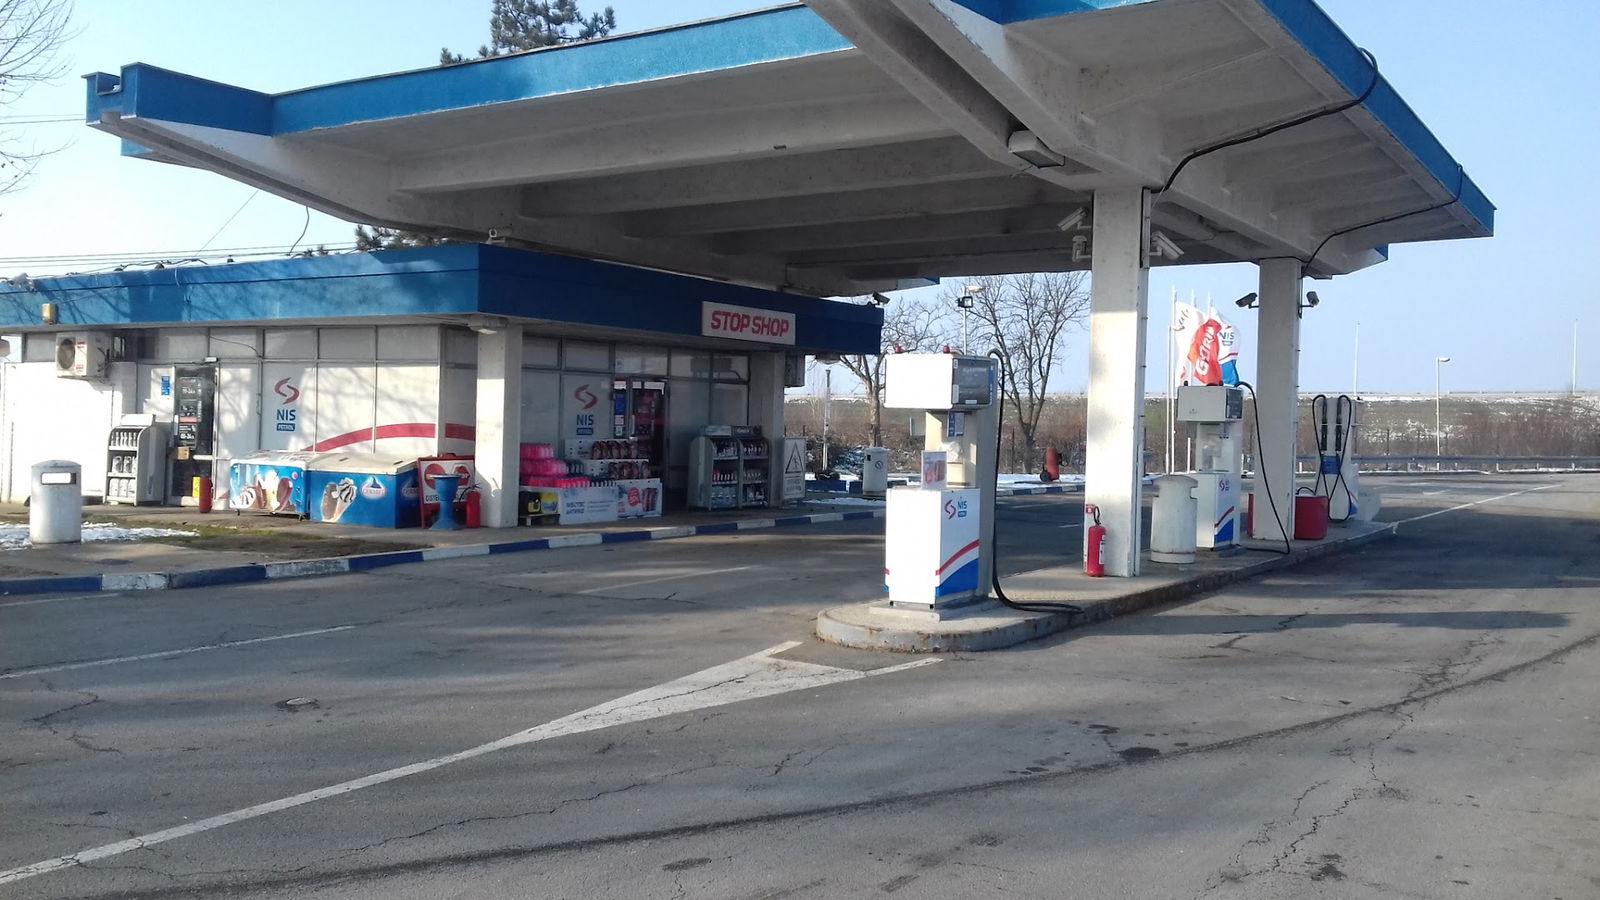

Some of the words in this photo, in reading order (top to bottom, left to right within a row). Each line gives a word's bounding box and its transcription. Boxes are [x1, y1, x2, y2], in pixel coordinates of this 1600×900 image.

[710, 310, 750, 332] STOP
[751, 315, 789, 337] SHOP
[276, 409, 296, 421] NIS
[576, 414, 594, 426] NIS
[957, 500, 968, 510] NIS
